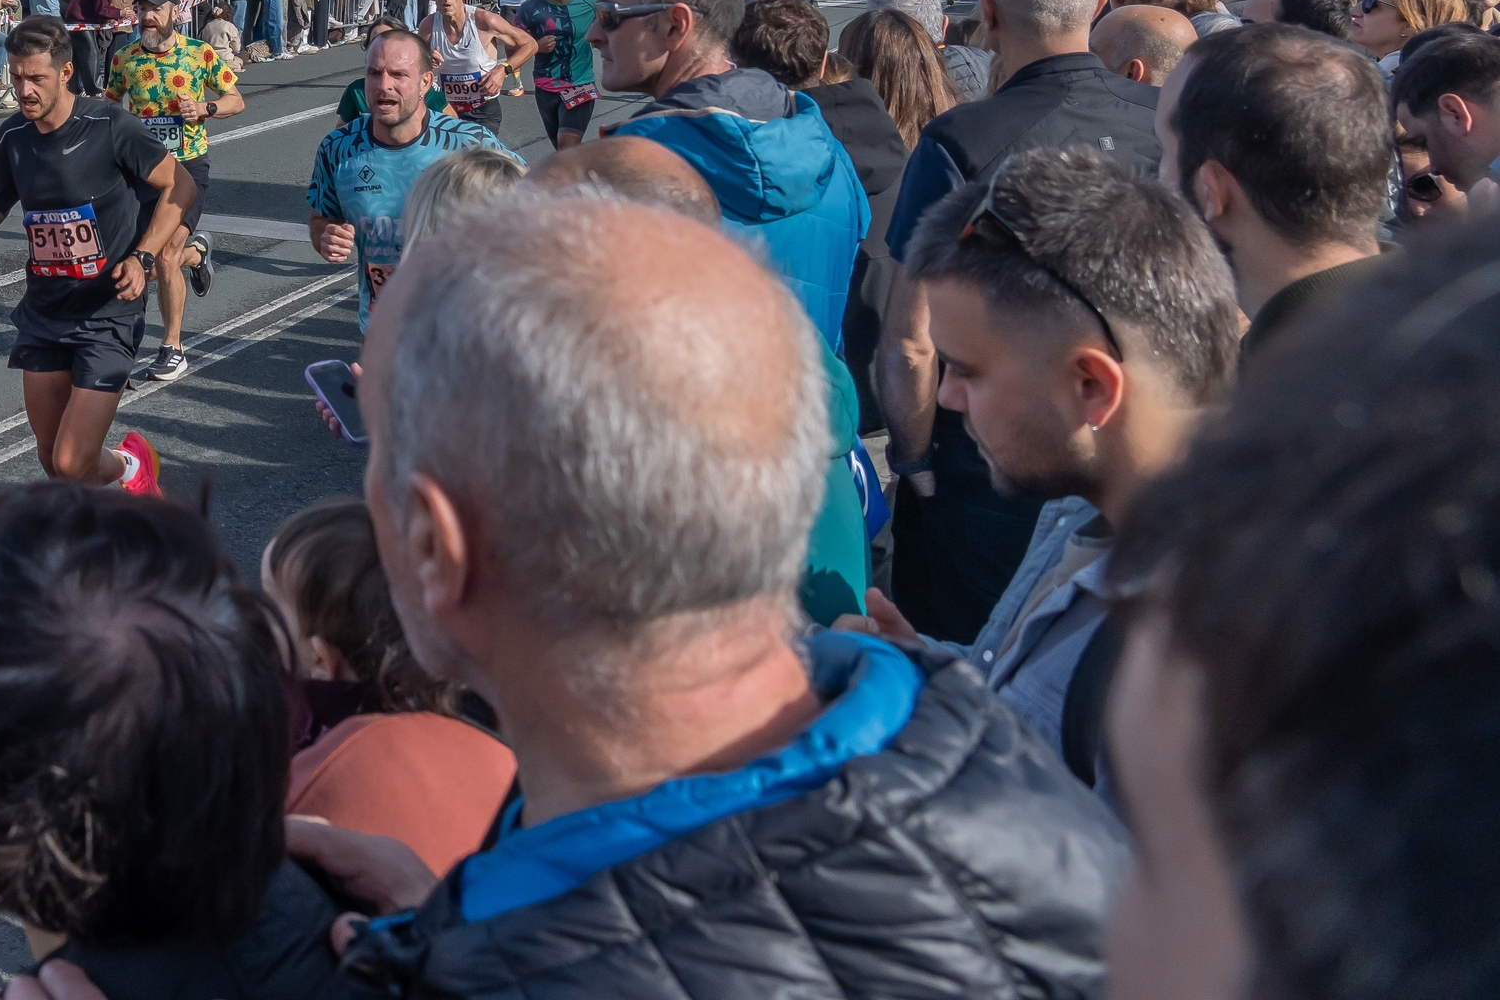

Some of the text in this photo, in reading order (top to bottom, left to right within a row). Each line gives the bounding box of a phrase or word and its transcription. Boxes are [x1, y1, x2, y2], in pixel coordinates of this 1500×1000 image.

[451, 74, 475, 82] Joma
[445, 83, 479, 95] 3090
[147, 116, 175, 125] Joma
[150, 127, 179, 141] 658
[354, 184, 382, 193] FORTUNA
[43, 210, 81, 223] Joma
[34, 224, 92, 248] 5130
[52, 251, 77, 259] RAUL
